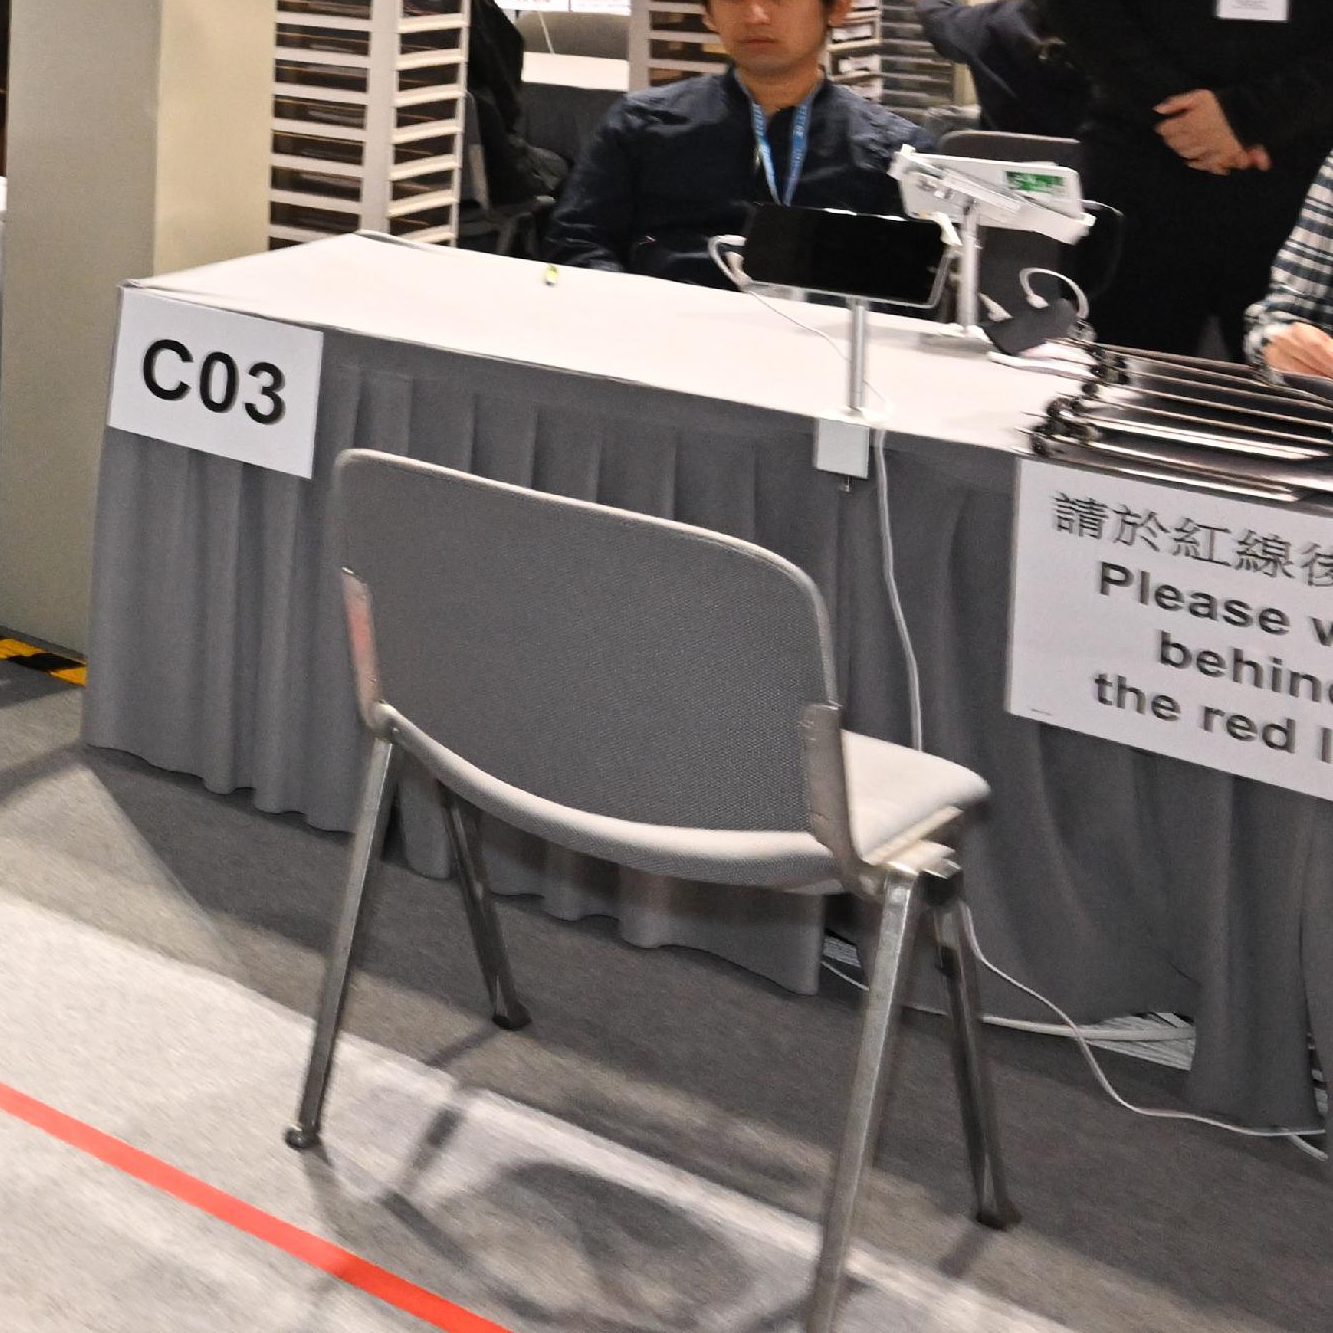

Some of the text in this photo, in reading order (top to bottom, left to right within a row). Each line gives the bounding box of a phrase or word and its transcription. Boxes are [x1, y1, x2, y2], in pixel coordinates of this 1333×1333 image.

[143, 338, 287, 426] C03
[1098, 561, 1290, 636] Please
[1157, 629, 1333, 705] behin
[1094, 672, 1181, 722] the
[1201, 704, 1296, 755] red
